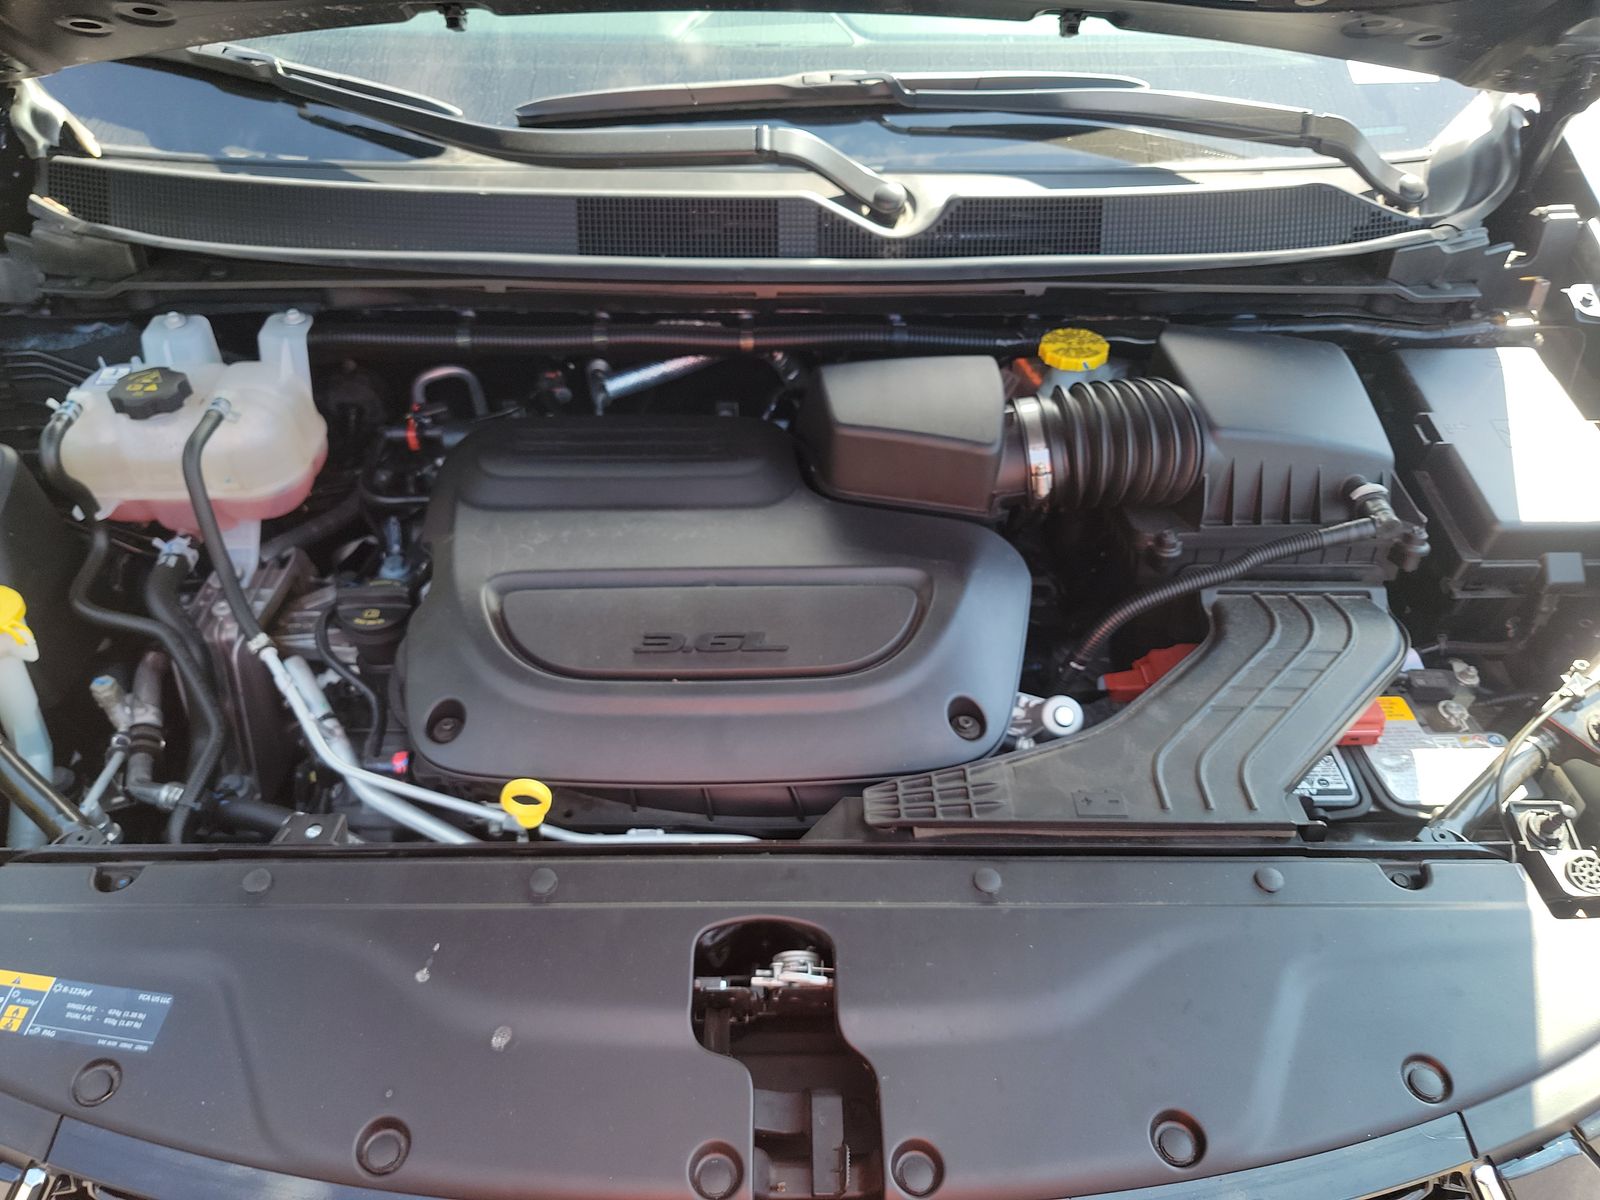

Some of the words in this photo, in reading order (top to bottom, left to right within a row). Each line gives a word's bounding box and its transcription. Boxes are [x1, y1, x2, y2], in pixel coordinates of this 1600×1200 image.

[633, 631, 789, 655] 3.6L
[62, 985, 93, 997] R-1234yf
[138, 993, 151, 1002] FCA
[159, 996, 173, 1004] LLC
